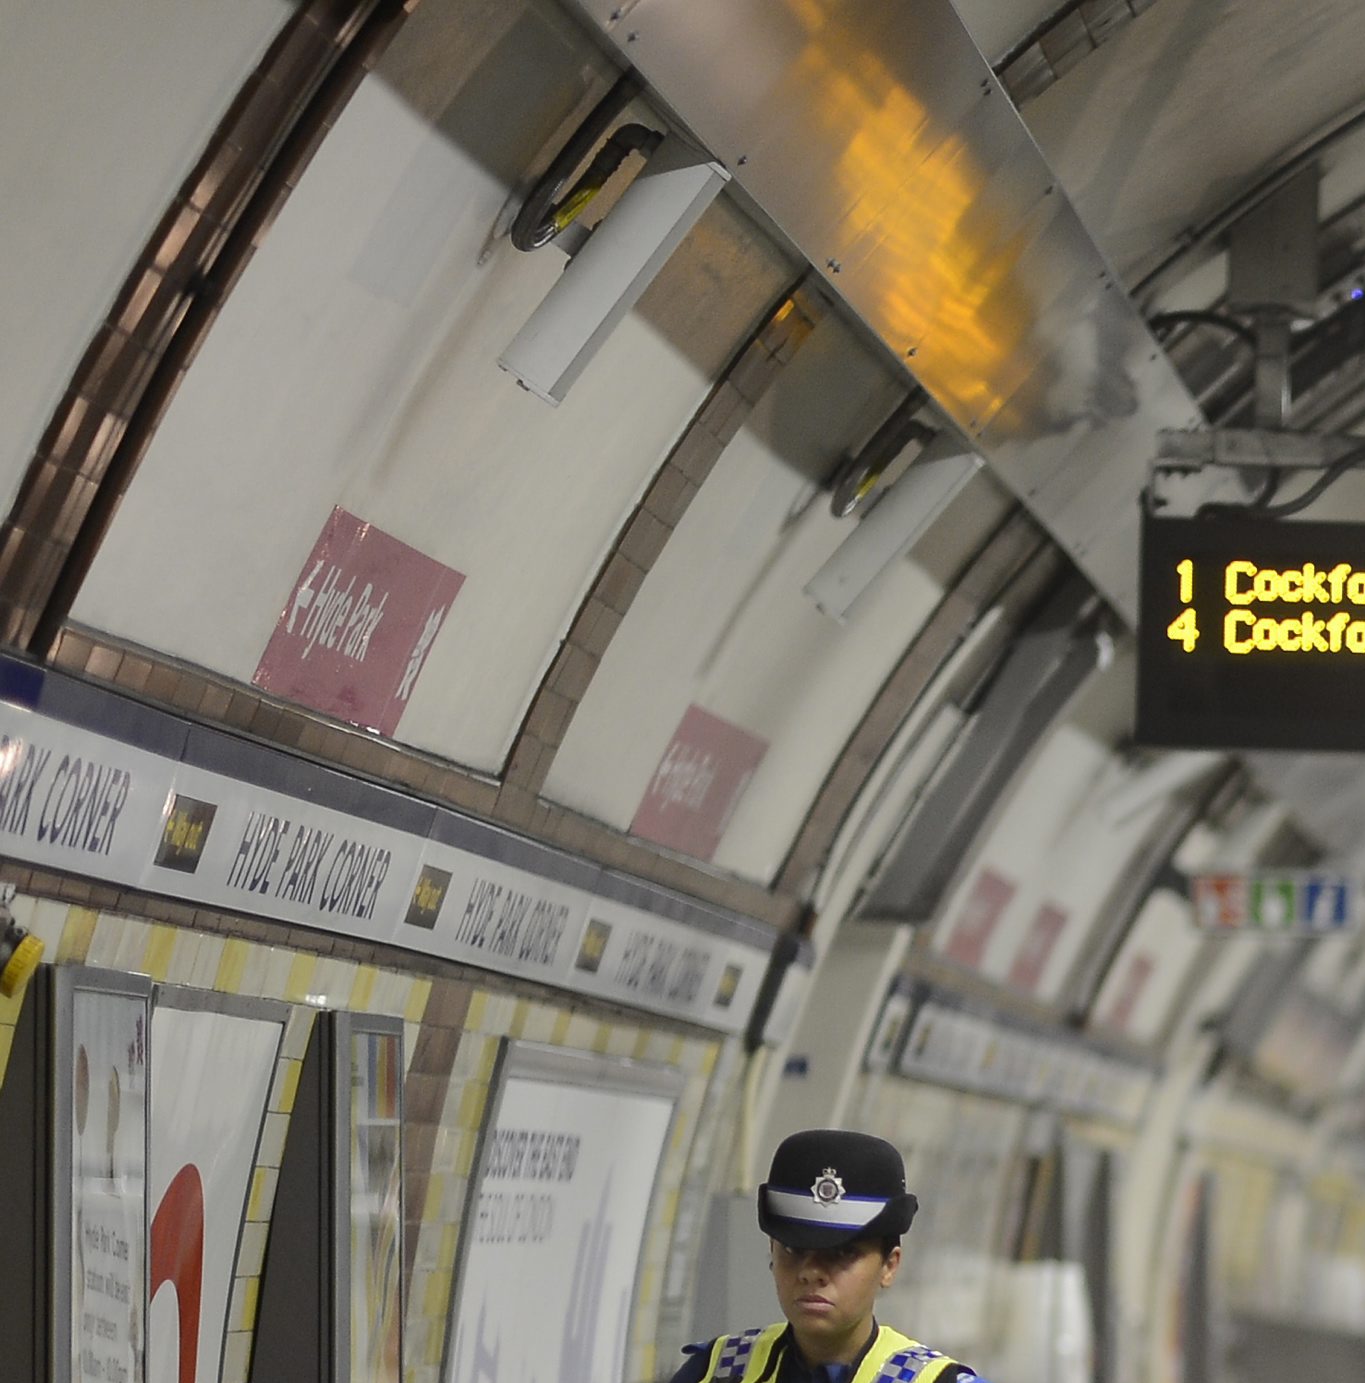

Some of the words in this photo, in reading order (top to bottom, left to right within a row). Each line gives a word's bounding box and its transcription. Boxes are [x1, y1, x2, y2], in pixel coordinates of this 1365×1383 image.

[300, 565, 357, 660] Hyde
[336, 582, 390, 663] Park
[1176, 559, 1194, 604] 1
[1167, 608, 1199, 653] 4
[36, 754, 131, 856] CORNER
[226, 810, 292, 895] HYDE
[274, 824, 335, 905] PARK
[318, 838, 392, 920] CORNER
[454, 876, 503, 949] HYDE
[488, 889, 533, 958] PARK
[517, 899, 570, 966] CORNER
